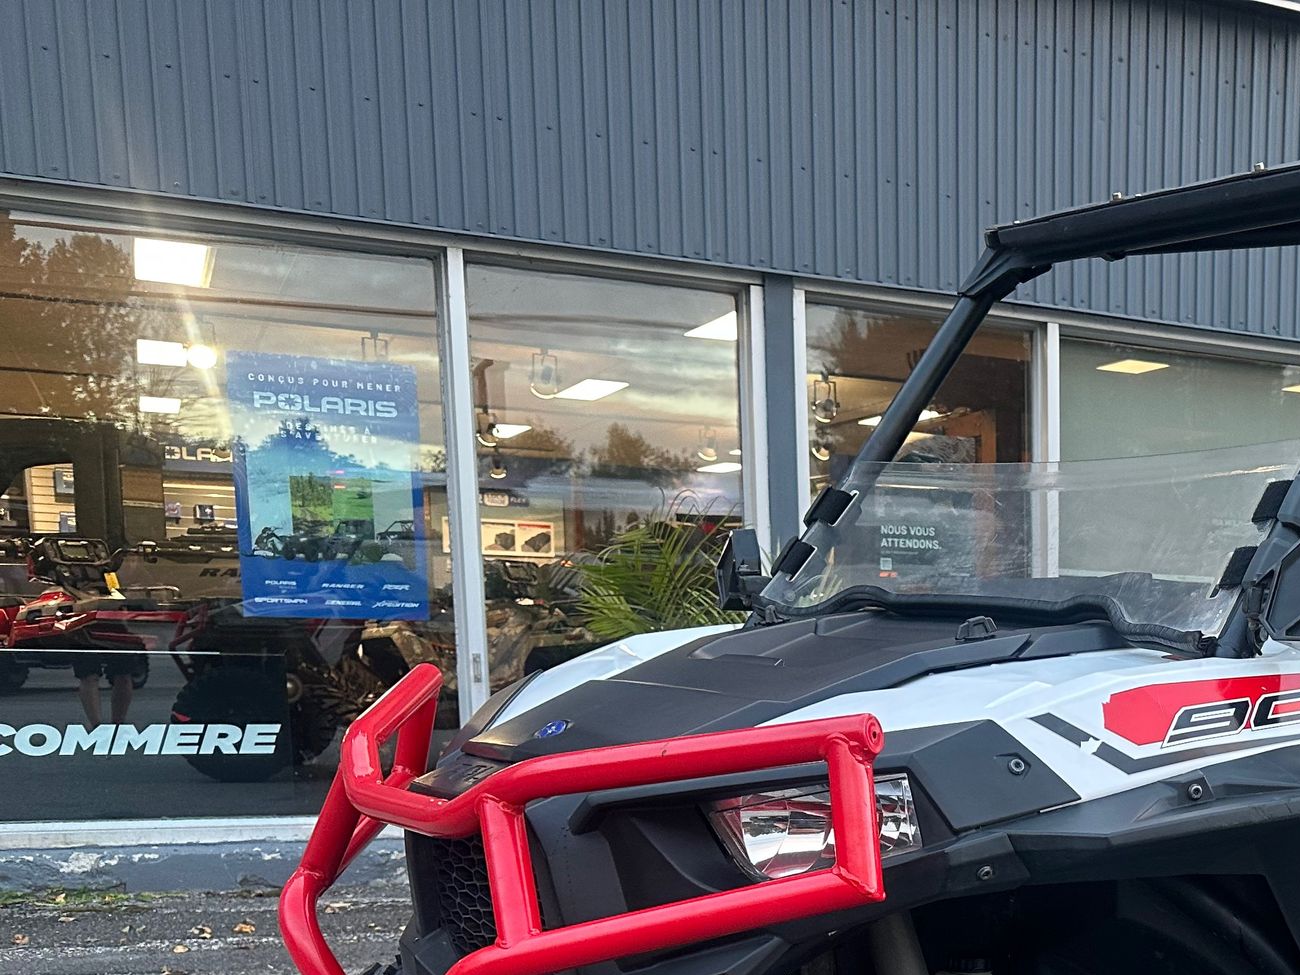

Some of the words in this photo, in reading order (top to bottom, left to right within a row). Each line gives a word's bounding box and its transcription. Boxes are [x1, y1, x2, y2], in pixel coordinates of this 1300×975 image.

[312, 378, 349, 389] POUR
[356, 381, 401, 393] MENER
[252, 390, 399, 419] POLARIS
[880, 525, 908, 535] NOUS
[909, 526, 936, 537] VOUS
[880, 537, 942, 550] ATTENDONS.
